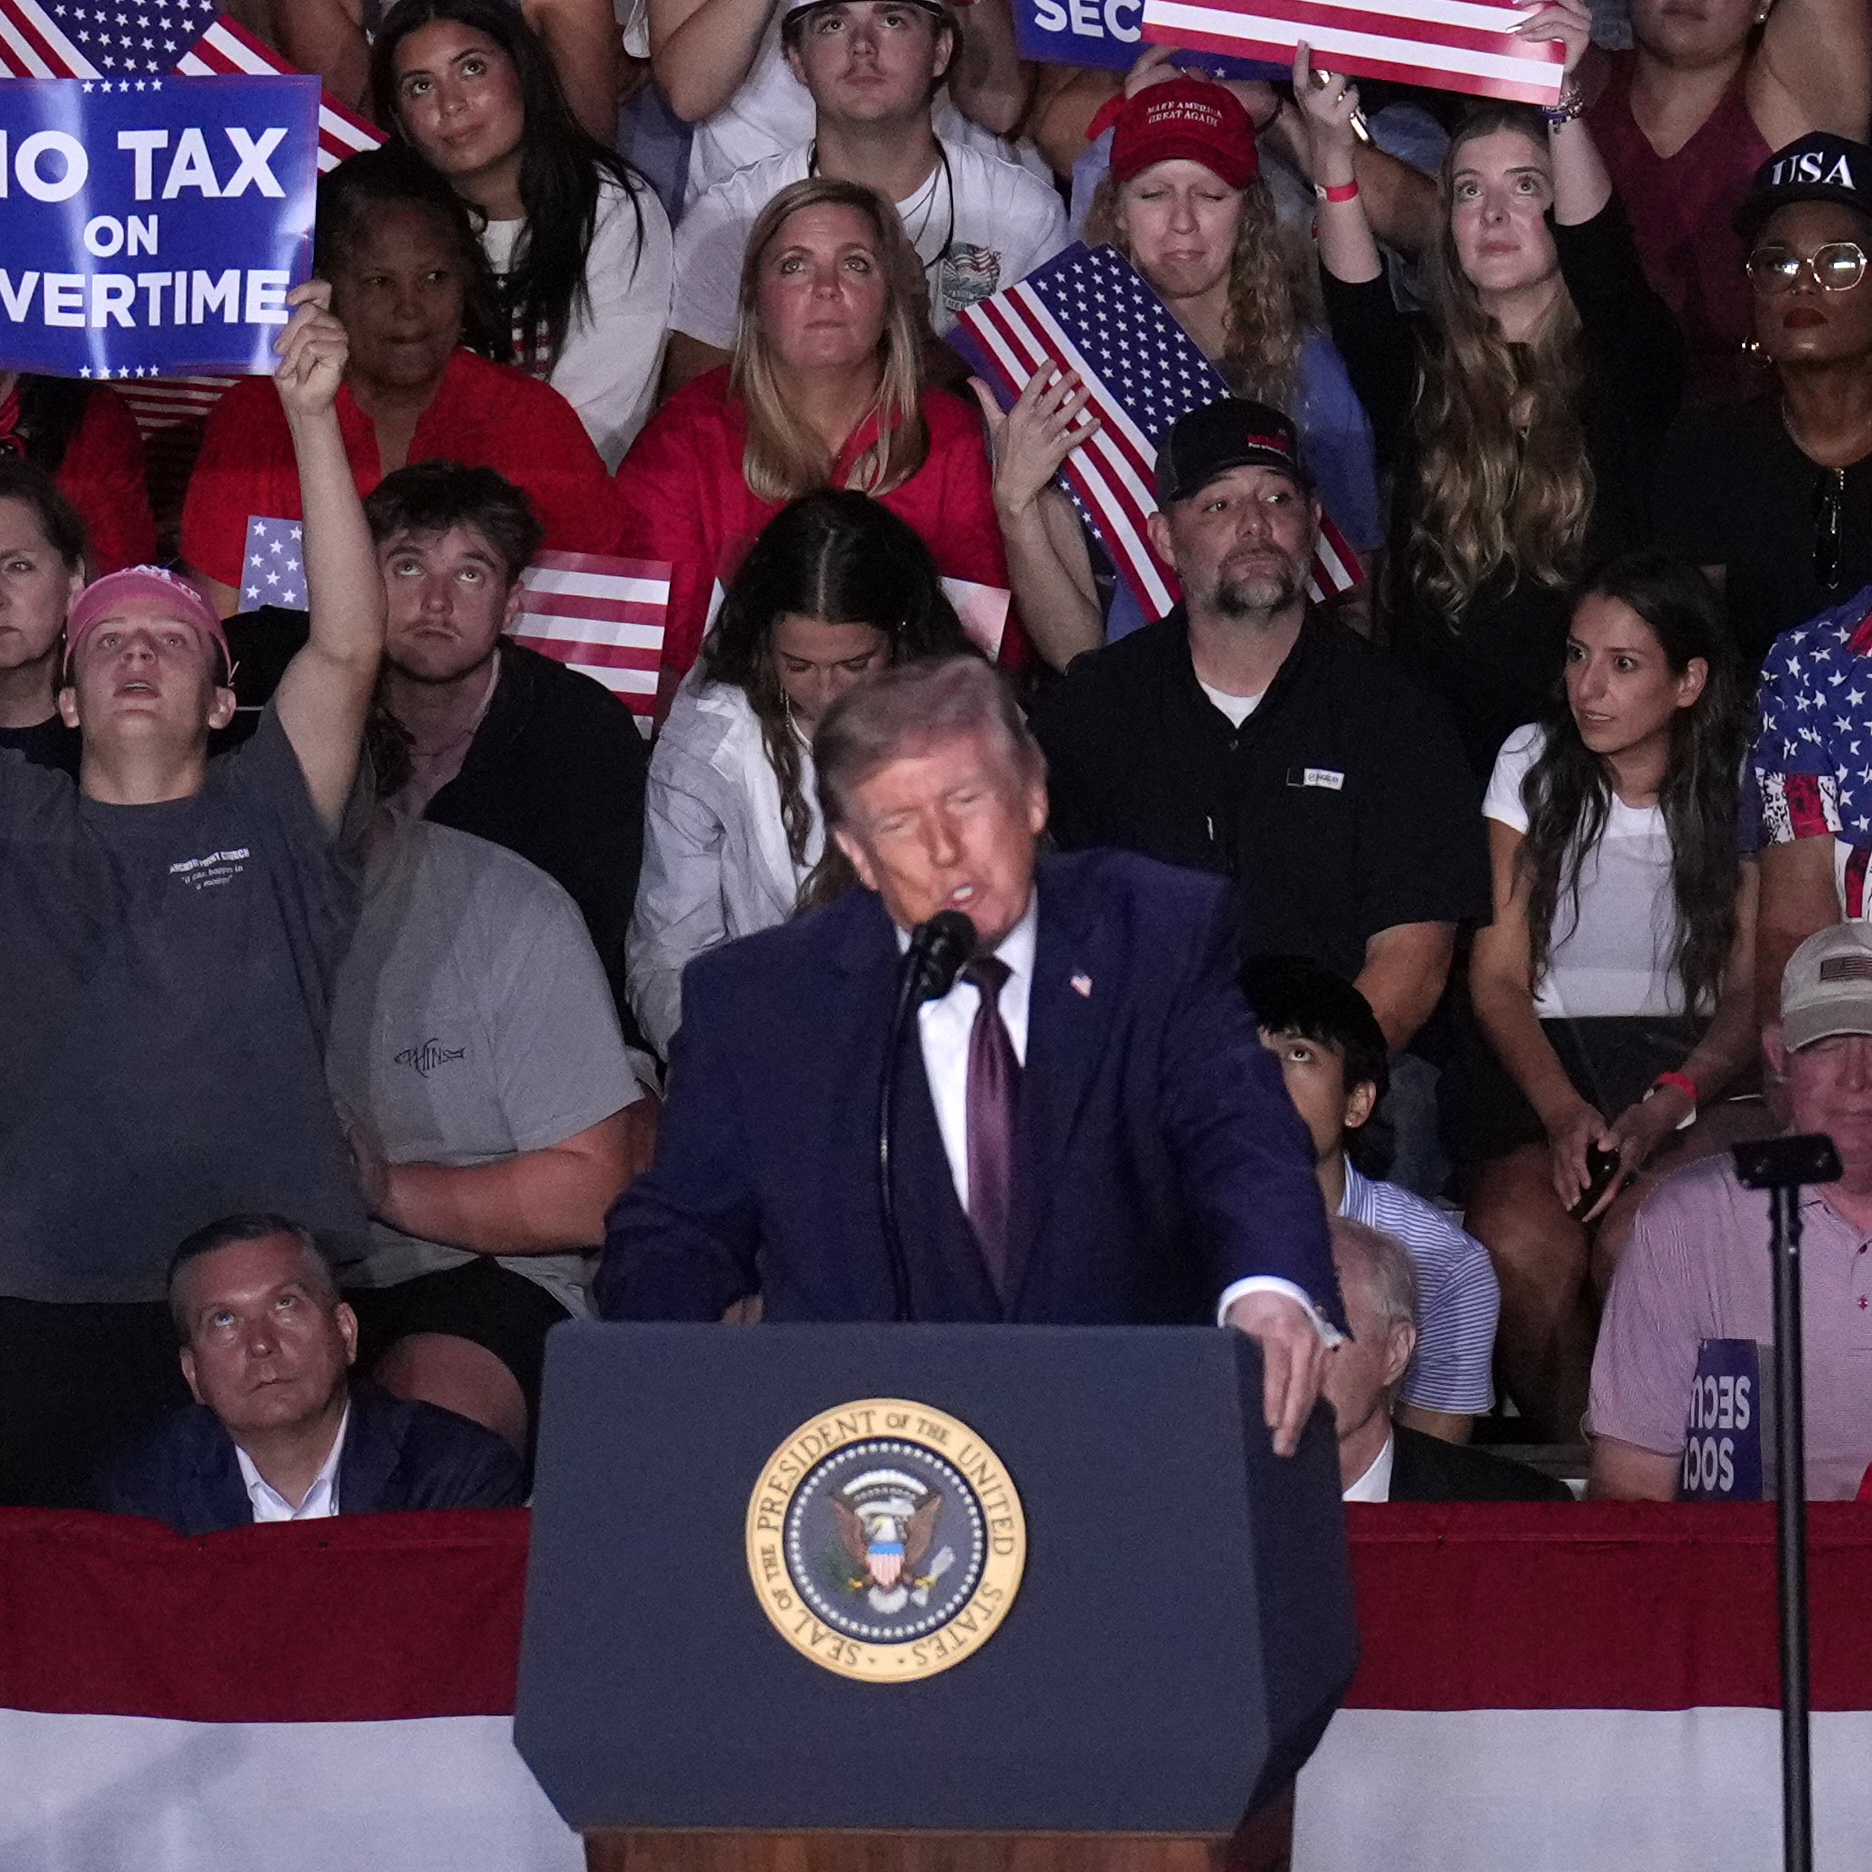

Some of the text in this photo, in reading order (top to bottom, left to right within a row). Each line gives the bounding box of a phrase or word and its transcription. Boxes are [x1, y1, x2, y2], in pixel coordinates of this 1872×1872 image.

[1146, 99, 1224, 118] MAKE AMERICA
[1148, 109, 1220, 127] GREAT AGAIN
[117, 125, 290, 200] TAX
[1772, 150, 1857, 190] USA
[82, 214, 160, 259] ON
[756, 1409, 1017, 1670] PRESIDENT OF THE UNITED STATES
[760, 1542, 863, 1667] SEAL OF THE
